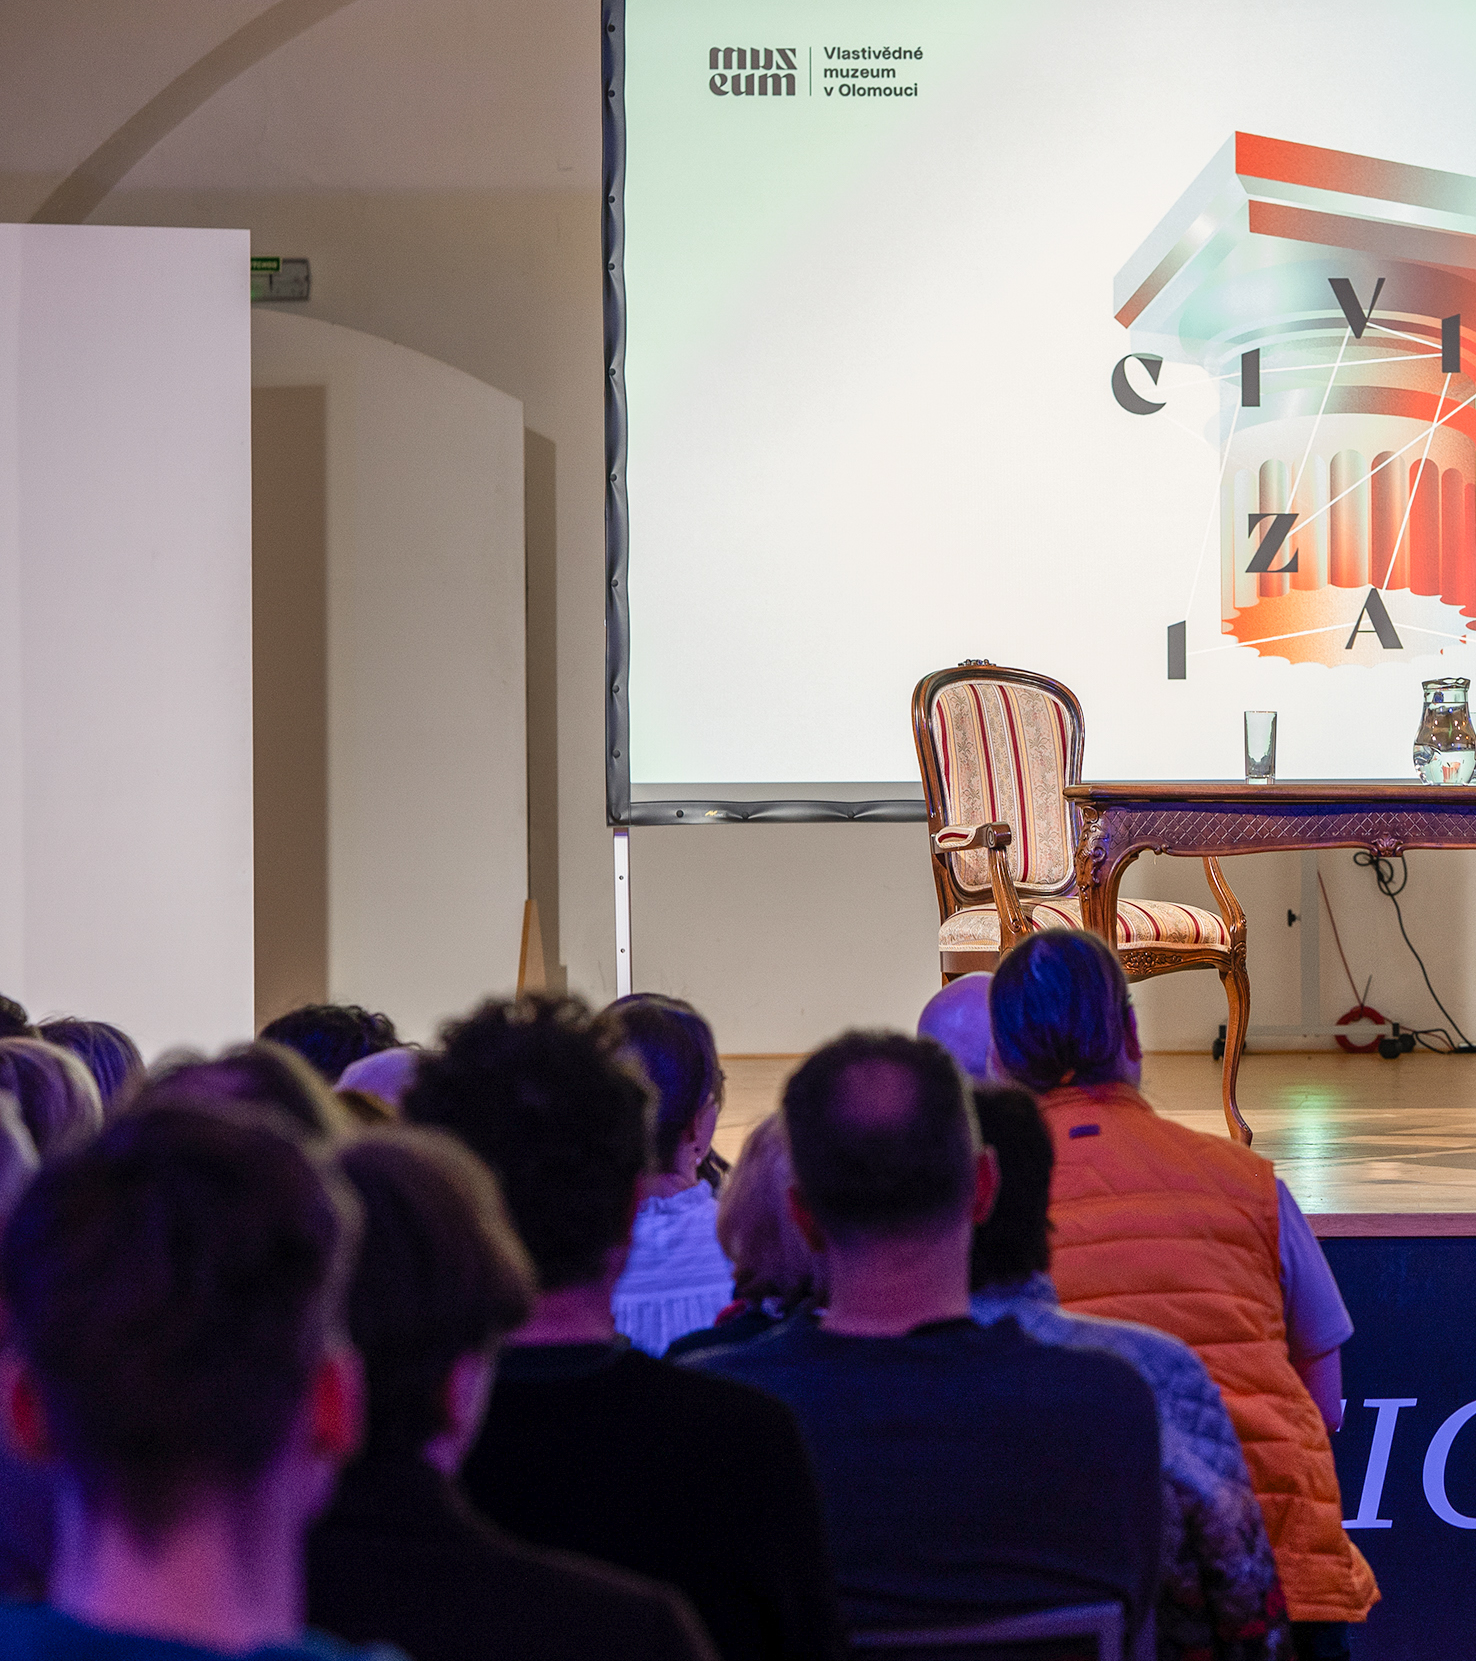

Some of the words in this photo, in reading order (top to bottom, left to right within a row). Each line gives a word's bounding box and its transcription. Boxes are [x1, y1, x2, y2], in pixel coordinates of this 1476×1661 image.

[823, 46, 924, 61] Vlastivědné
[823, 67, 897, 79] muzeum
[823, 86, 835, 97] v
[838, 83, 918, 97] Olomouci
